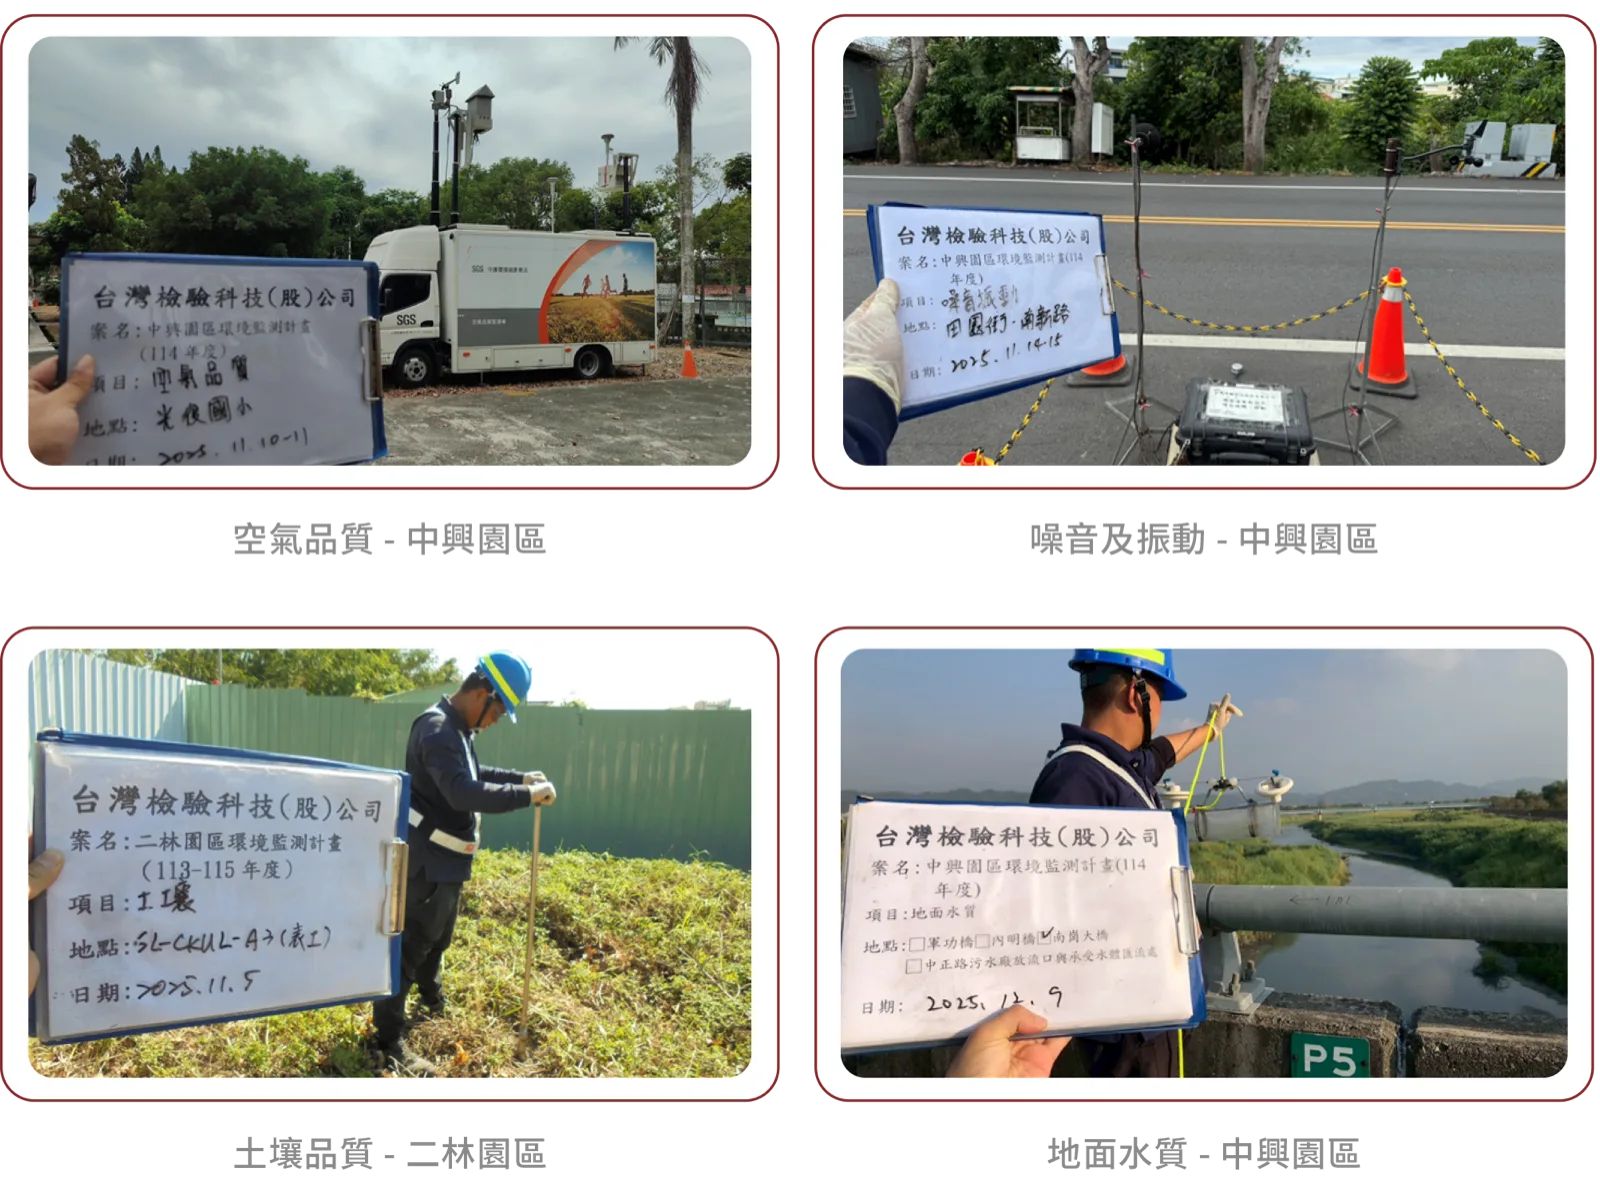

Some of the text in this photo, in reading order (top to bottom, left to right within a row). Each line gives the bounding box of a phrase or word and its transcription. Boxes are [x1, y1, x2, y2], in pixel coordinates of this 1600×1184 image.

[897, 225, 1090, 246] 台灣檢驗科技(股)公司
[94, 285, 355, 309] 台灣檢驗科技(股)公司
[396, 314, 417, 326] SGS
[72, 784, 382, 822] 台灣檢驗科技(股)公司
[875, 824, 1159, 848] 台灣檢驗科技(股)公司
[1304, 1043, 1357, 1077] P5
